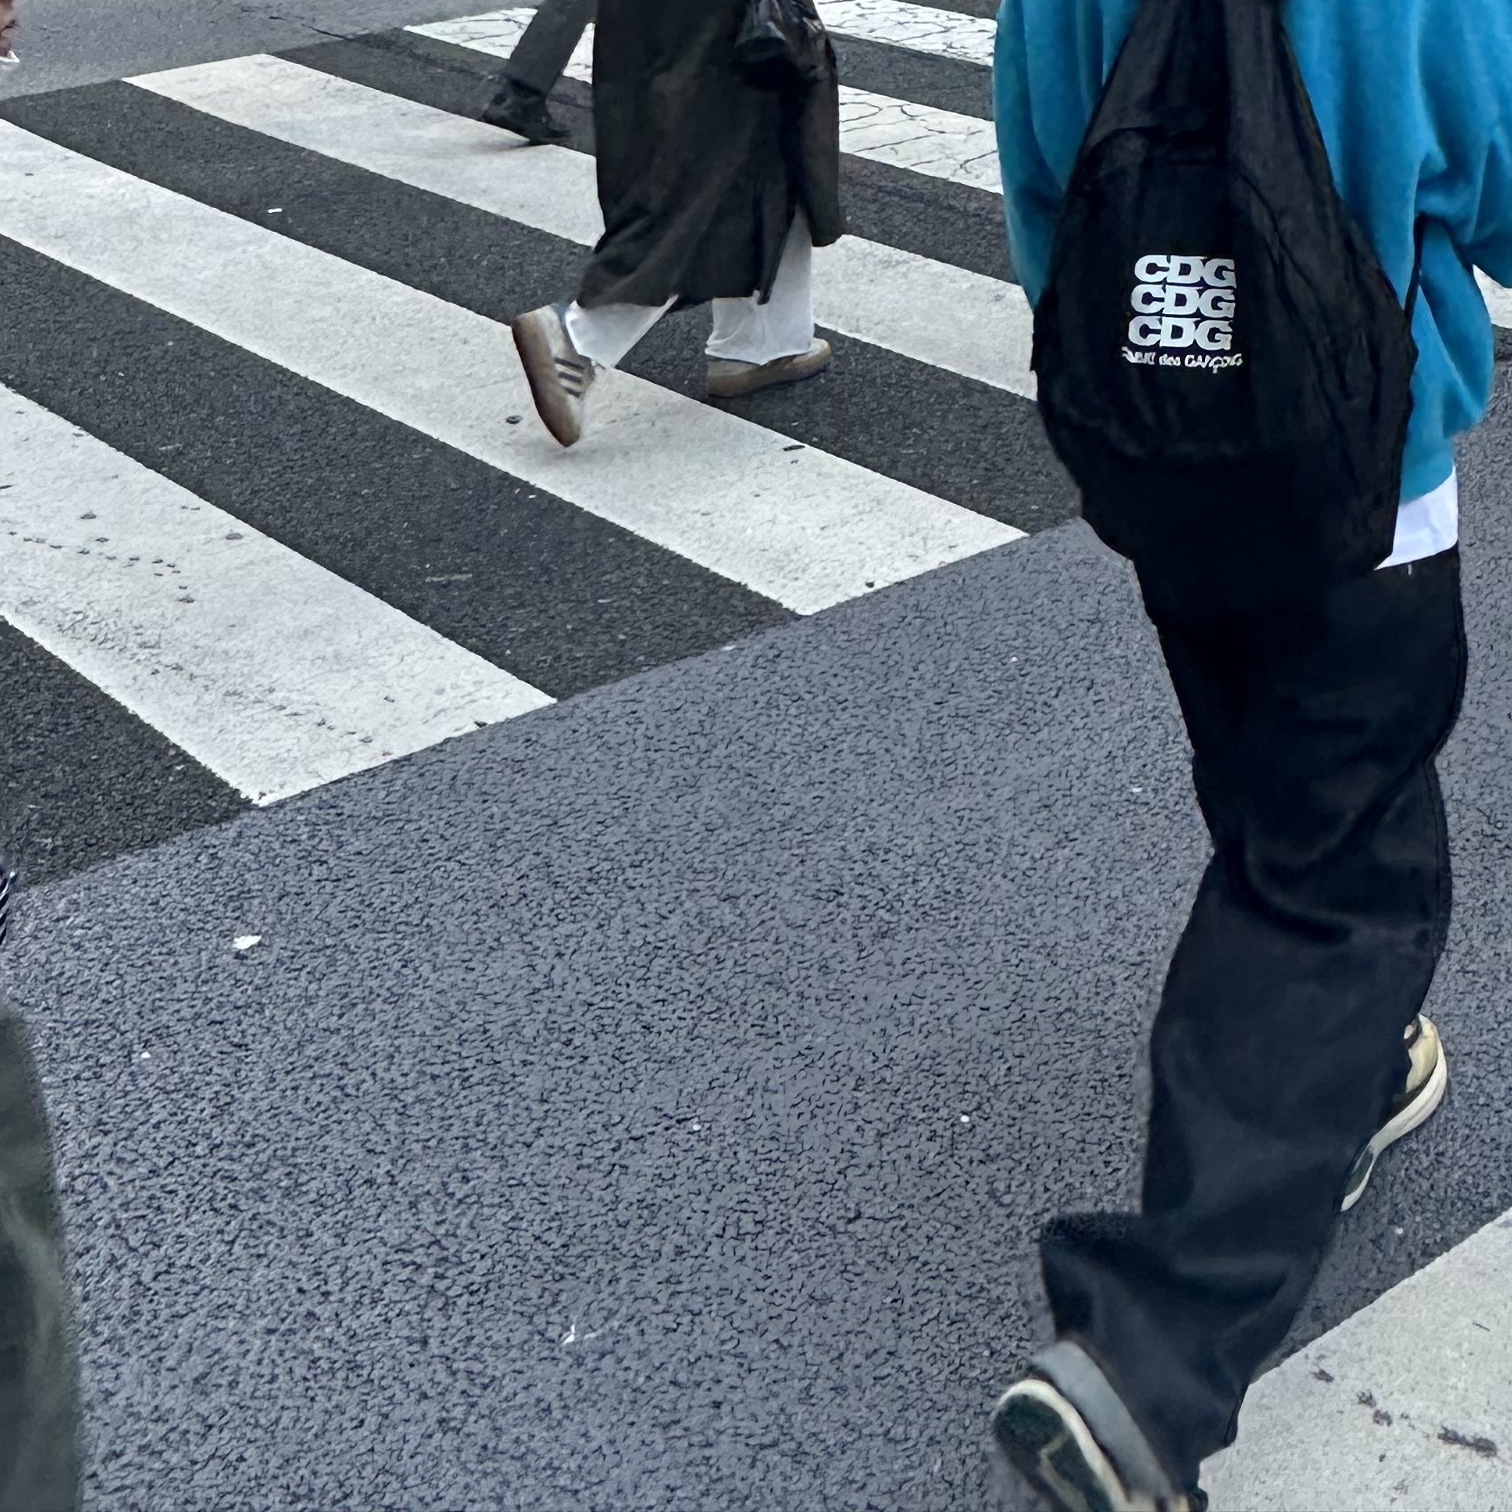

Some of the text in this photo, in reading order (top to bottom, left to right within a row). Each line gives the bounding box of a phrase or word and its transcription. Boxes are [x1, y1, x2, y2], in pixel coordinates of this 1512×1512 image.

[1134, 254, 1237, 289] CDG
[1131, 284, 1236, 319] CDG
[1128, 315, 1233, 350] CDG
